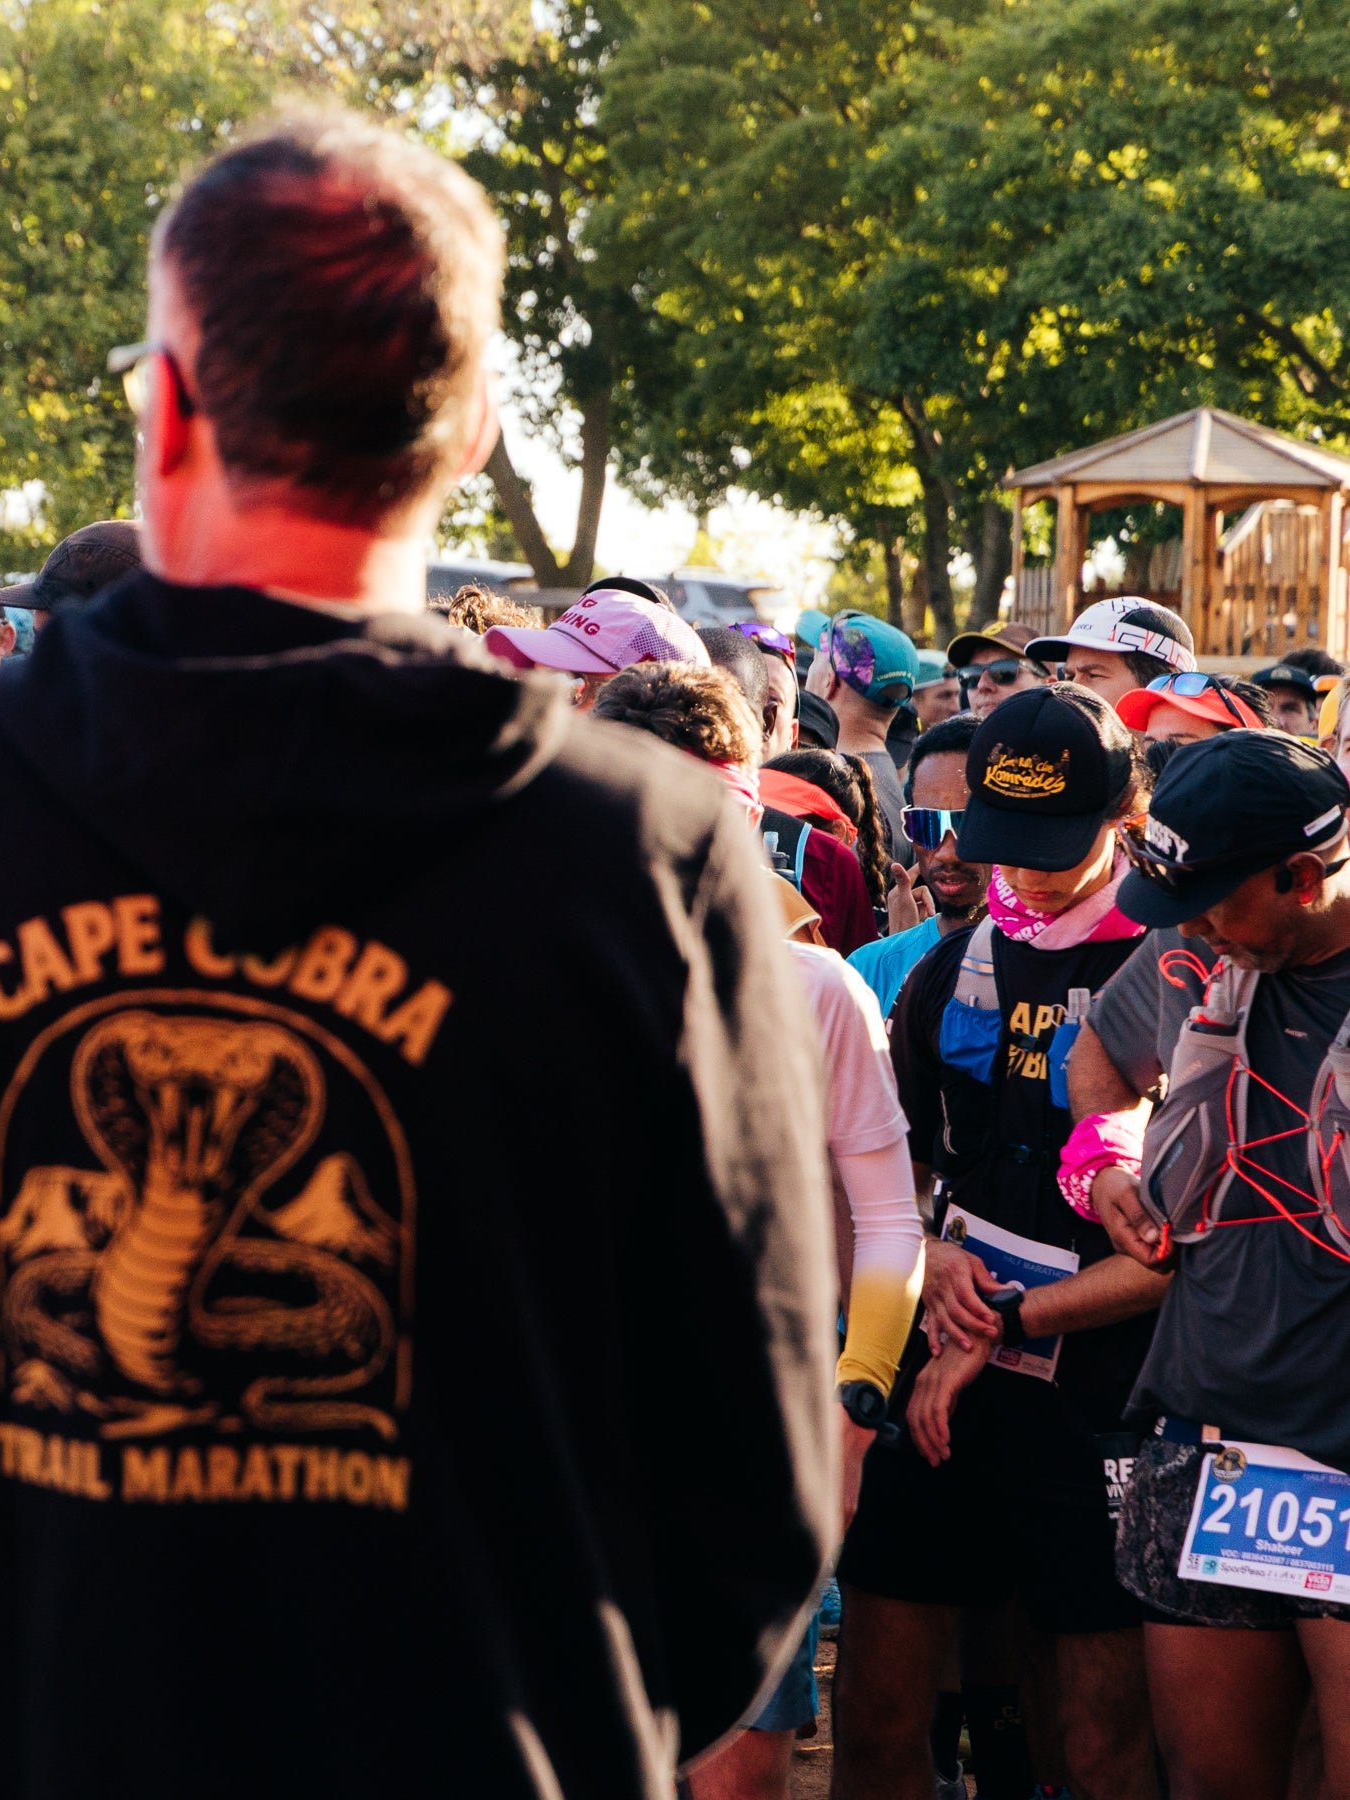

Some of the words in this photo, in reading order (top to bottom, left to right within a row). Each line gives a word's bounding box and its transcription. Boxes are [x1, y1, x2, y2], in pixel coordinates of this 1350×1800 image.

[995, 877, 1018, 909] BRA
[120, 1443, 410, 1513] MARATHON
[1255, 1539, 1303, 1556] Shabeer
